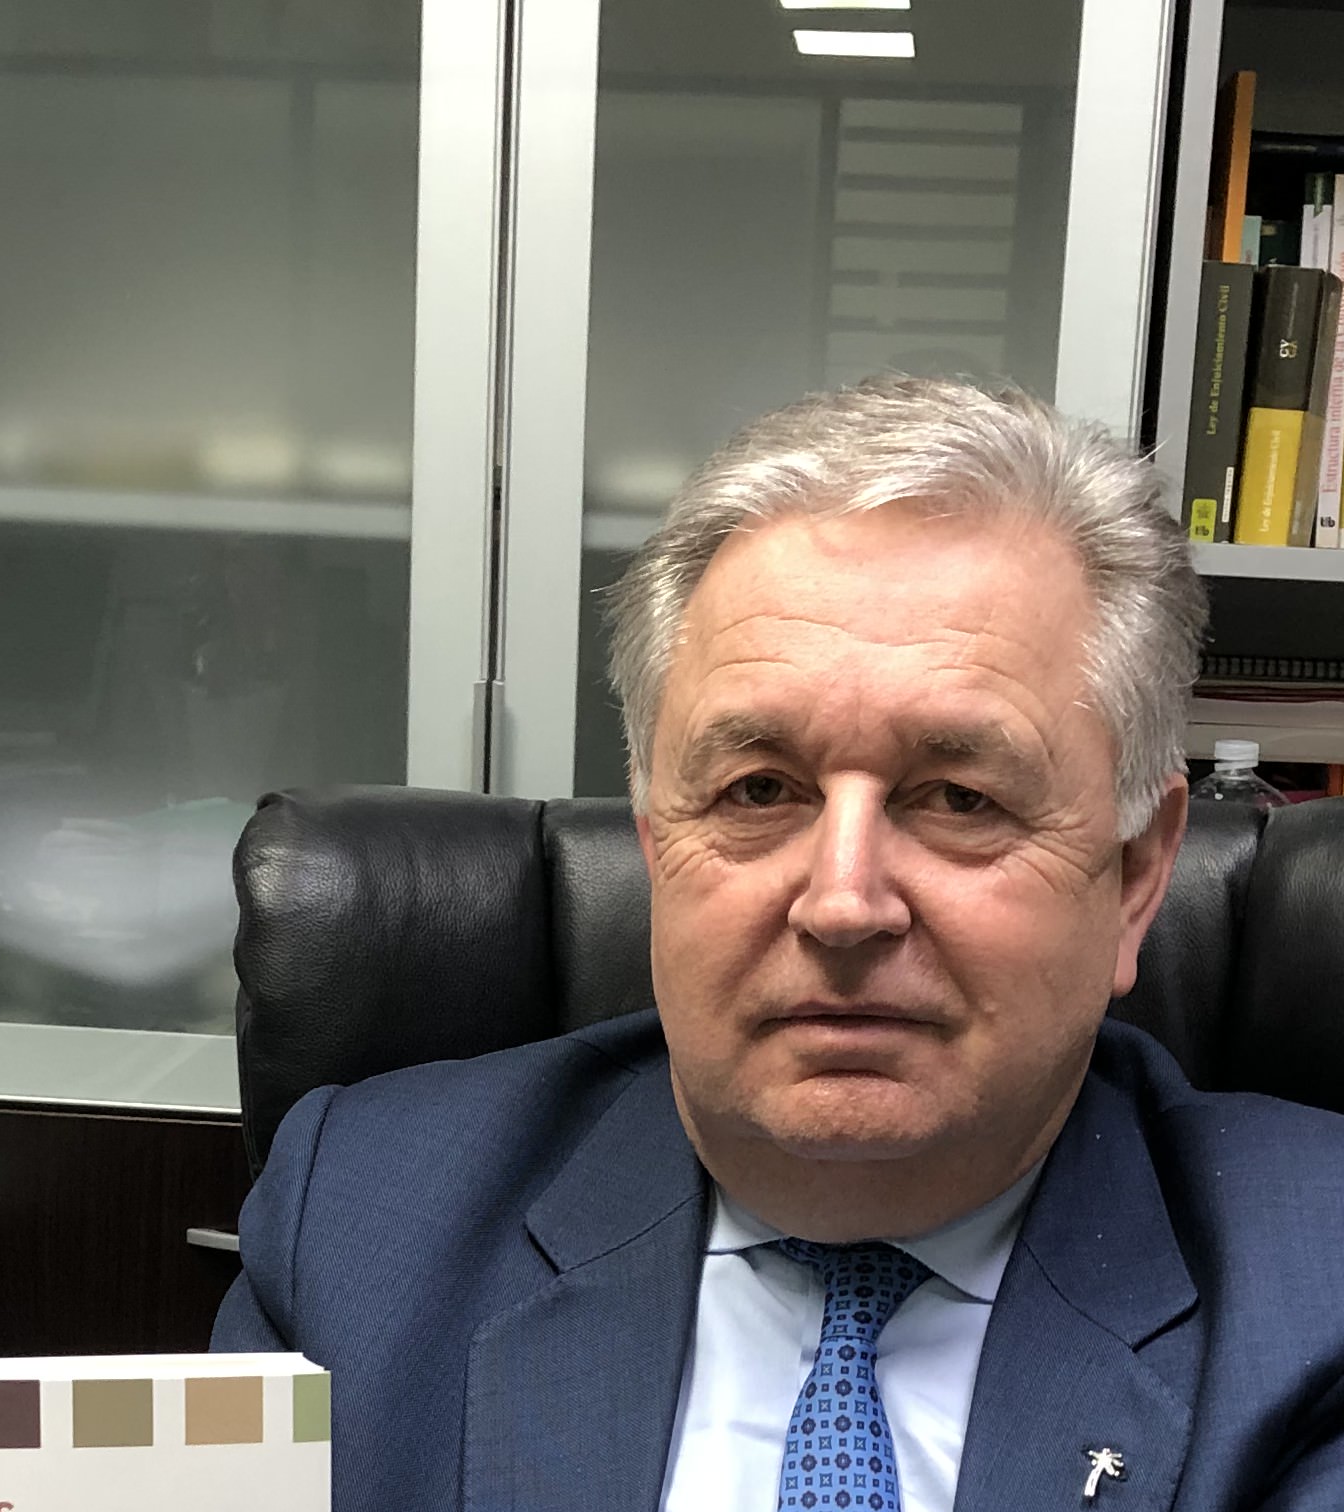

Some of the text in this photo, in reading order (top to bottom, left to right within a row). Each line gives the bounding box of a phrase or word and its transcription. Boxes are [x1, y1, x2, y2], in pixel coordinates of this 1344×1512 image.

[1207, 285, 1231, 434] Ley de Enjuiciamiento Civil
[1330, 357, 1344, 373] de
[1328, 377, 1344, 422] interna
[1322, 426, 1340, 493] Estructura
